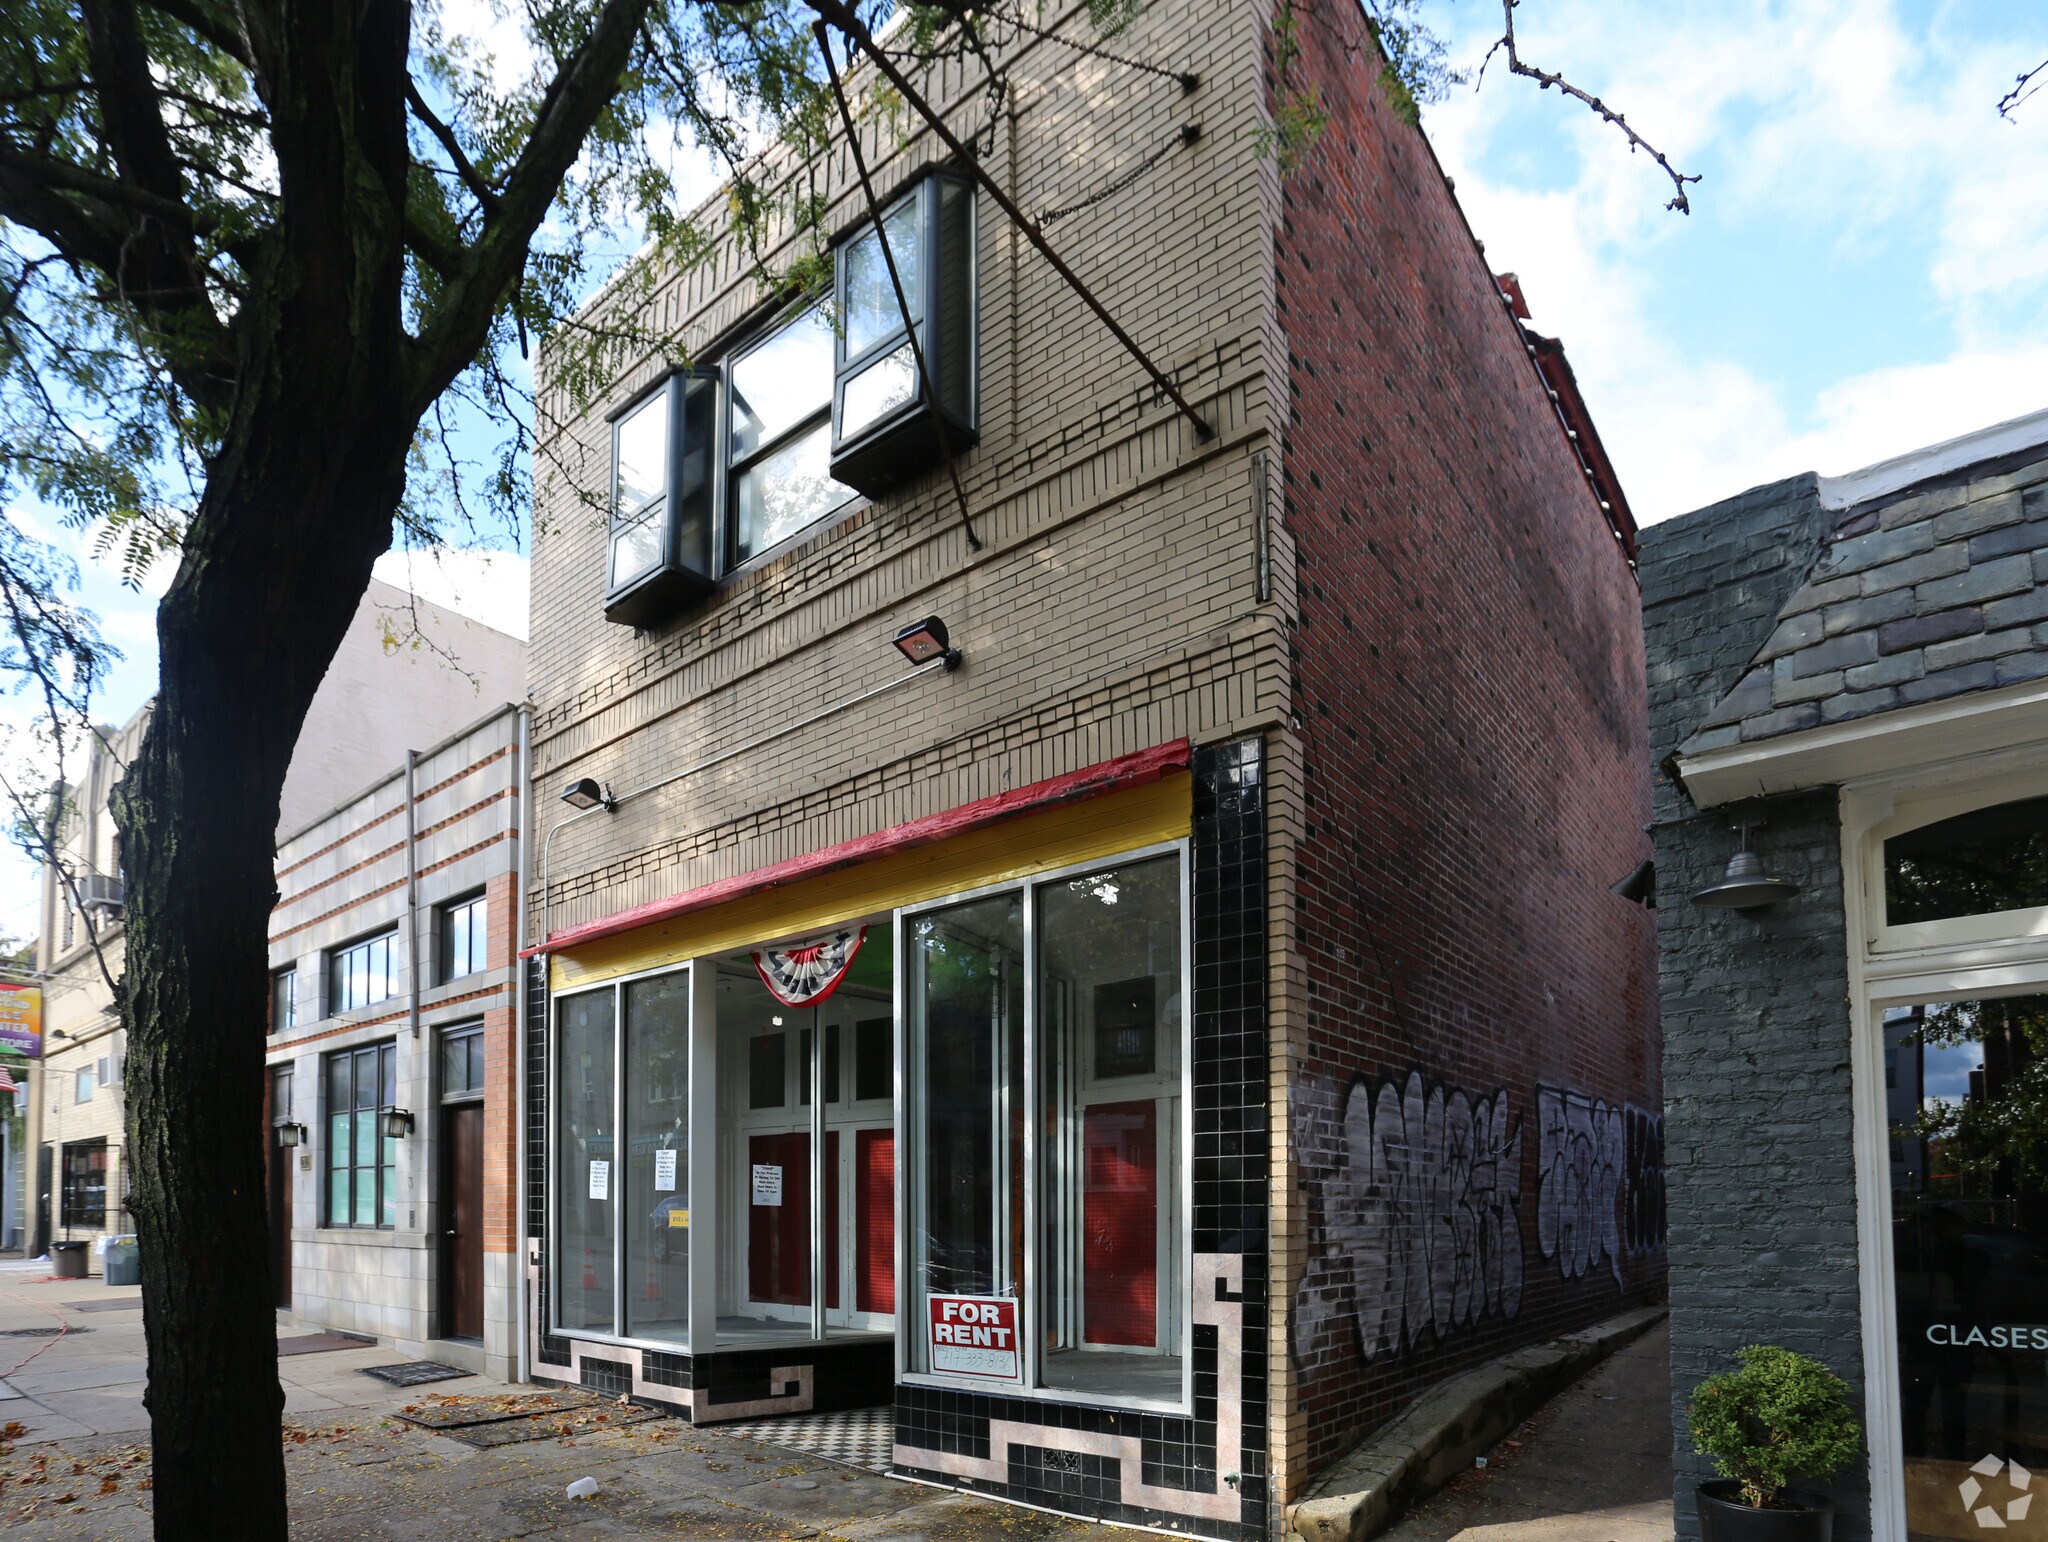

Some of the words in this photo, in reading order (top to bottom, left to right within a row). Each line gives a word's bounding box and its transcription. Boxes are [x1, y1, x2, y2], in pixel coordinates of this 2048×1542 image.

[942, 1302, 1000, 1325] FOR
[934, 1322, 1011, 1348] RENT
[1926, 1324, 2048, 1350] CLASES
